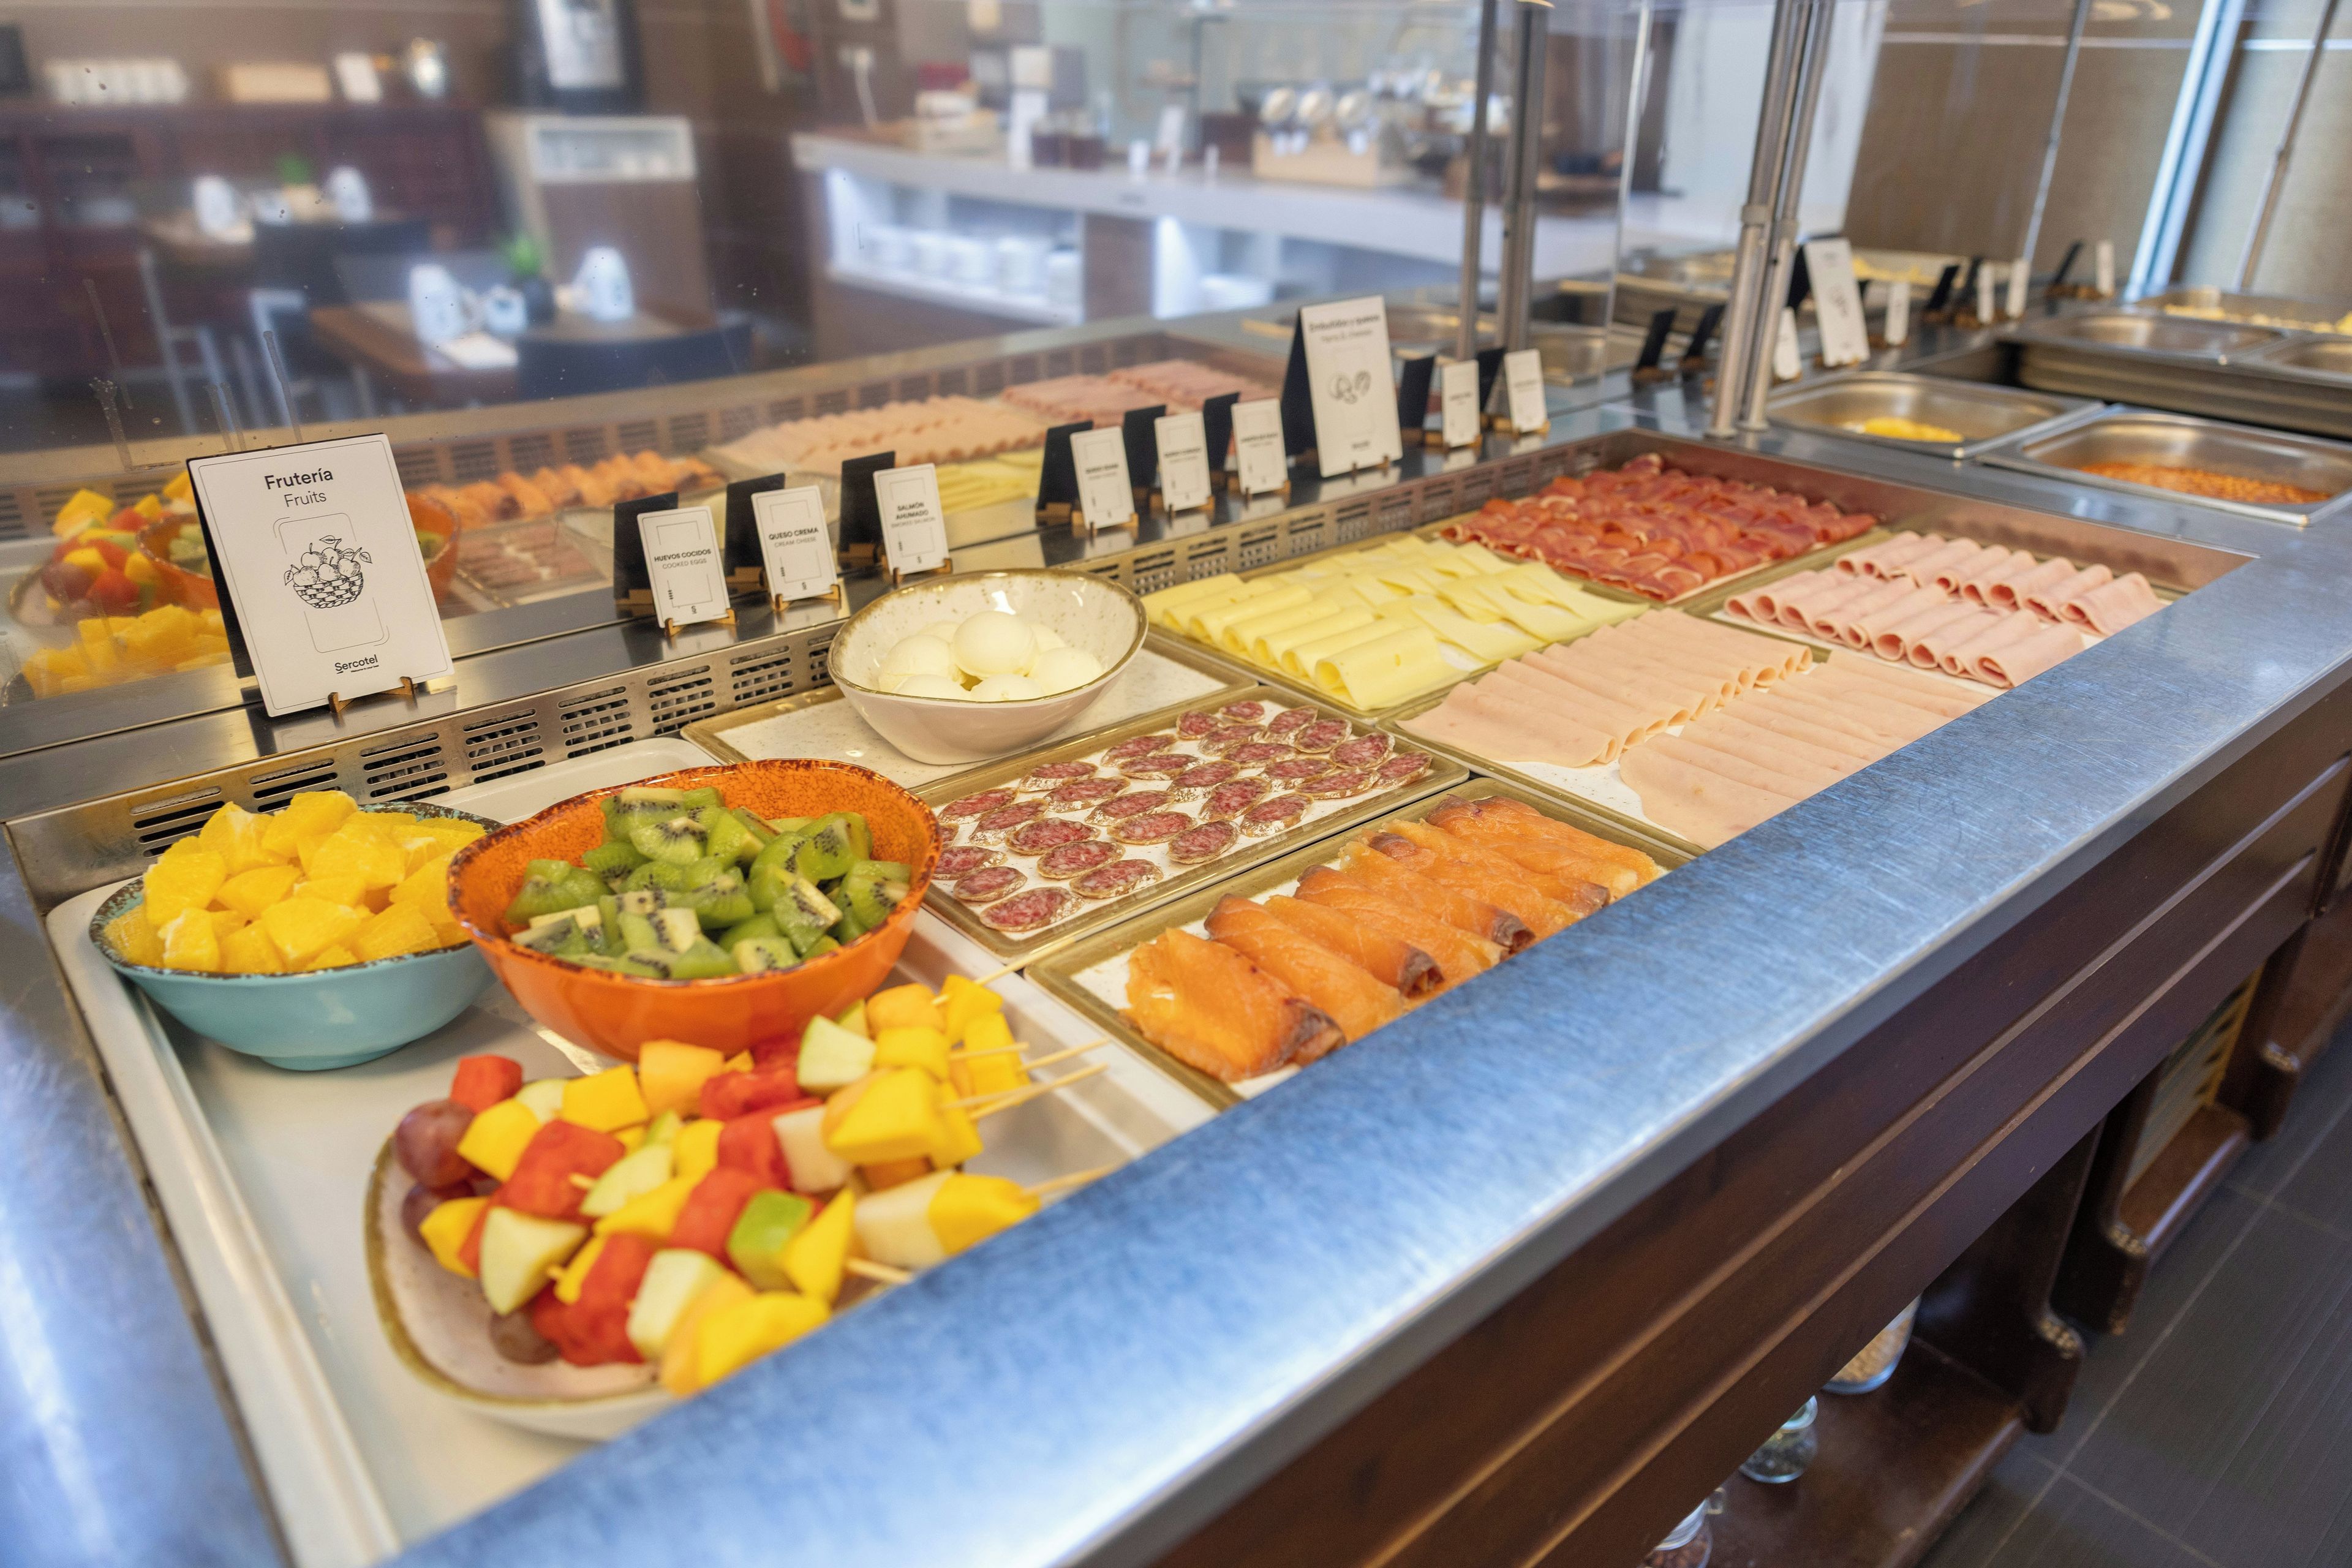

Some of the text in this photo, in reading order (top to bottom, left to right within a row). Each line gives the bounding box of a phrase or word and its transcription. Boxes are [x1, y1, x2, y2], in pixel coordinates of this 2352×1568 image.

[264, 468, 333, 489] Frutería
[284, 491, 326, 507] Fruits
[769, 527, 818, 540] QUESO CREMA
[654, 549, 711, 562] HUEVOS COCIDOS
[662, 560, 688, 570] COOKED
[334, 654, 378, 673] Sercotel
